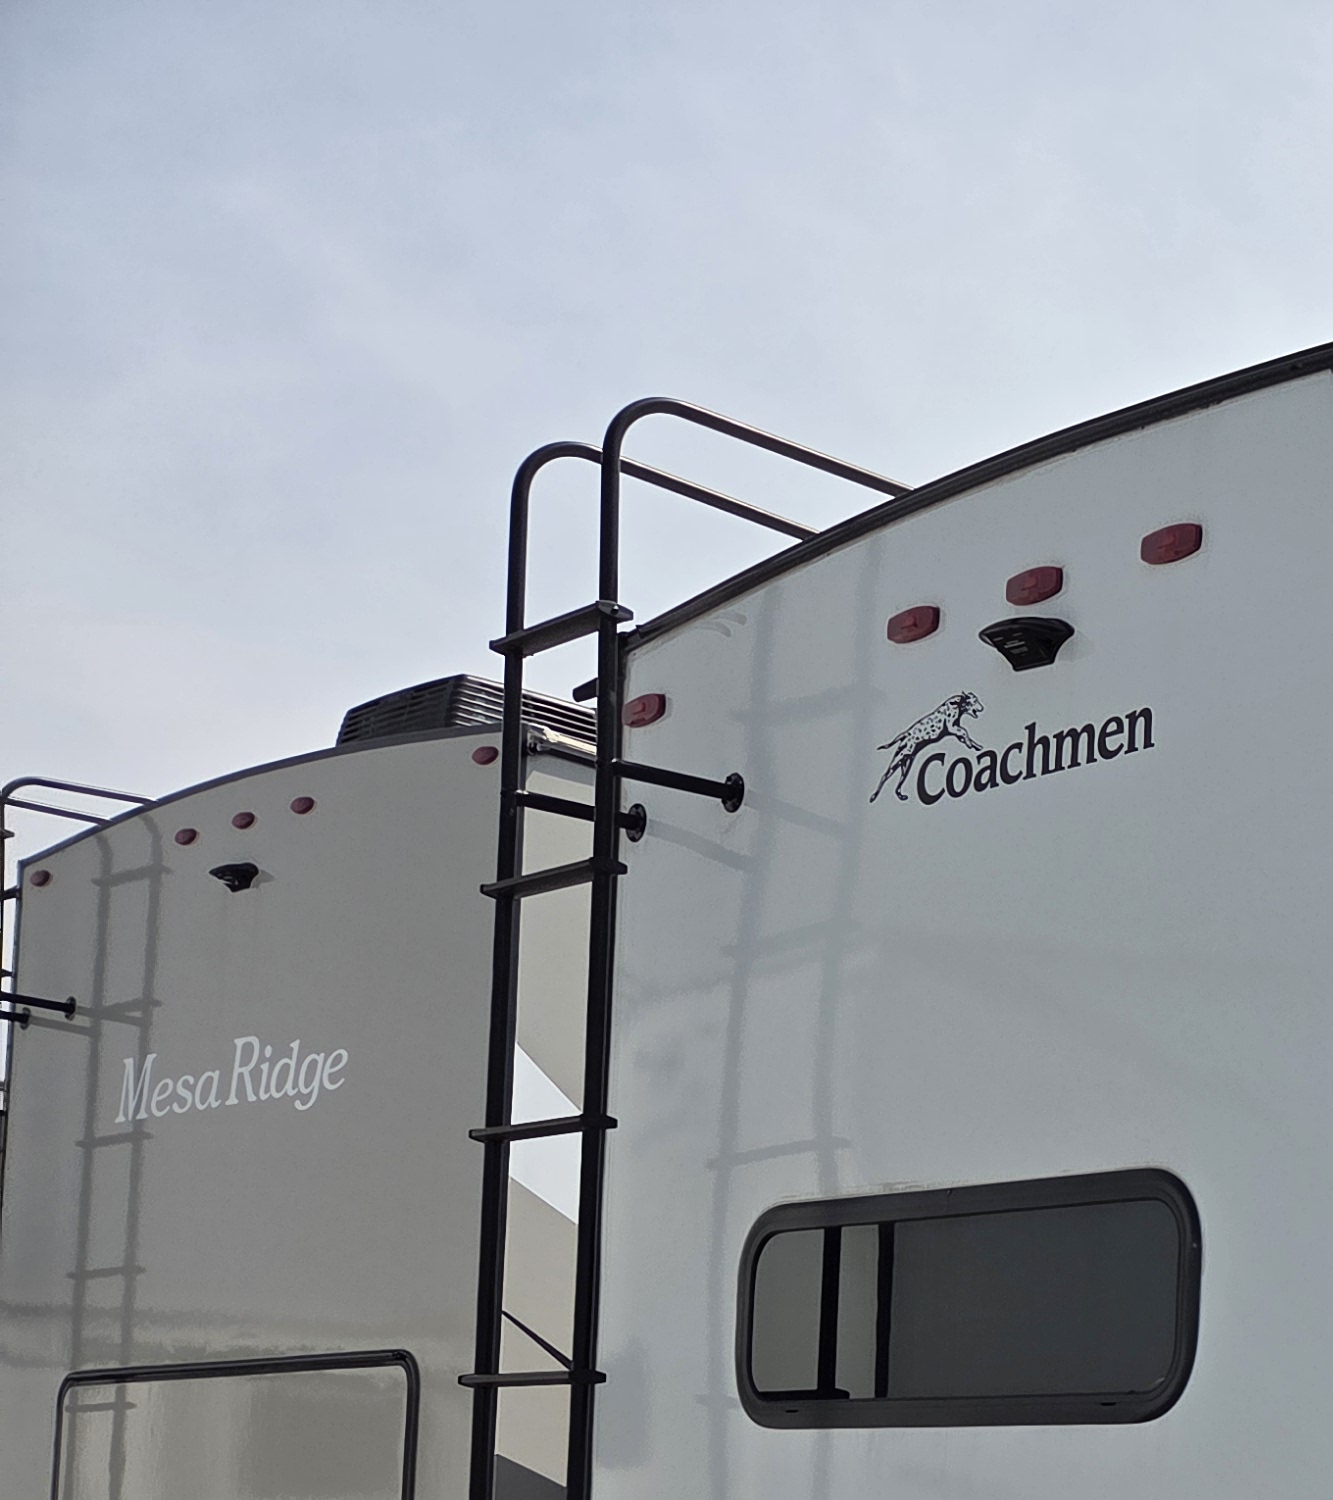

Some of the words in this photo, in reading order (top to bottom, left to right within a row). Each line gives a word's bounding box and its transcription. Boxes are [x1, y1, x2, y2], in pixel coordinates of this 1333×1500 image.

[916, 706, 1155, 805] Coachmen
[114, 1053, 222, 1123] Mesa
[225, 1035, 349, 1111] Ridge
